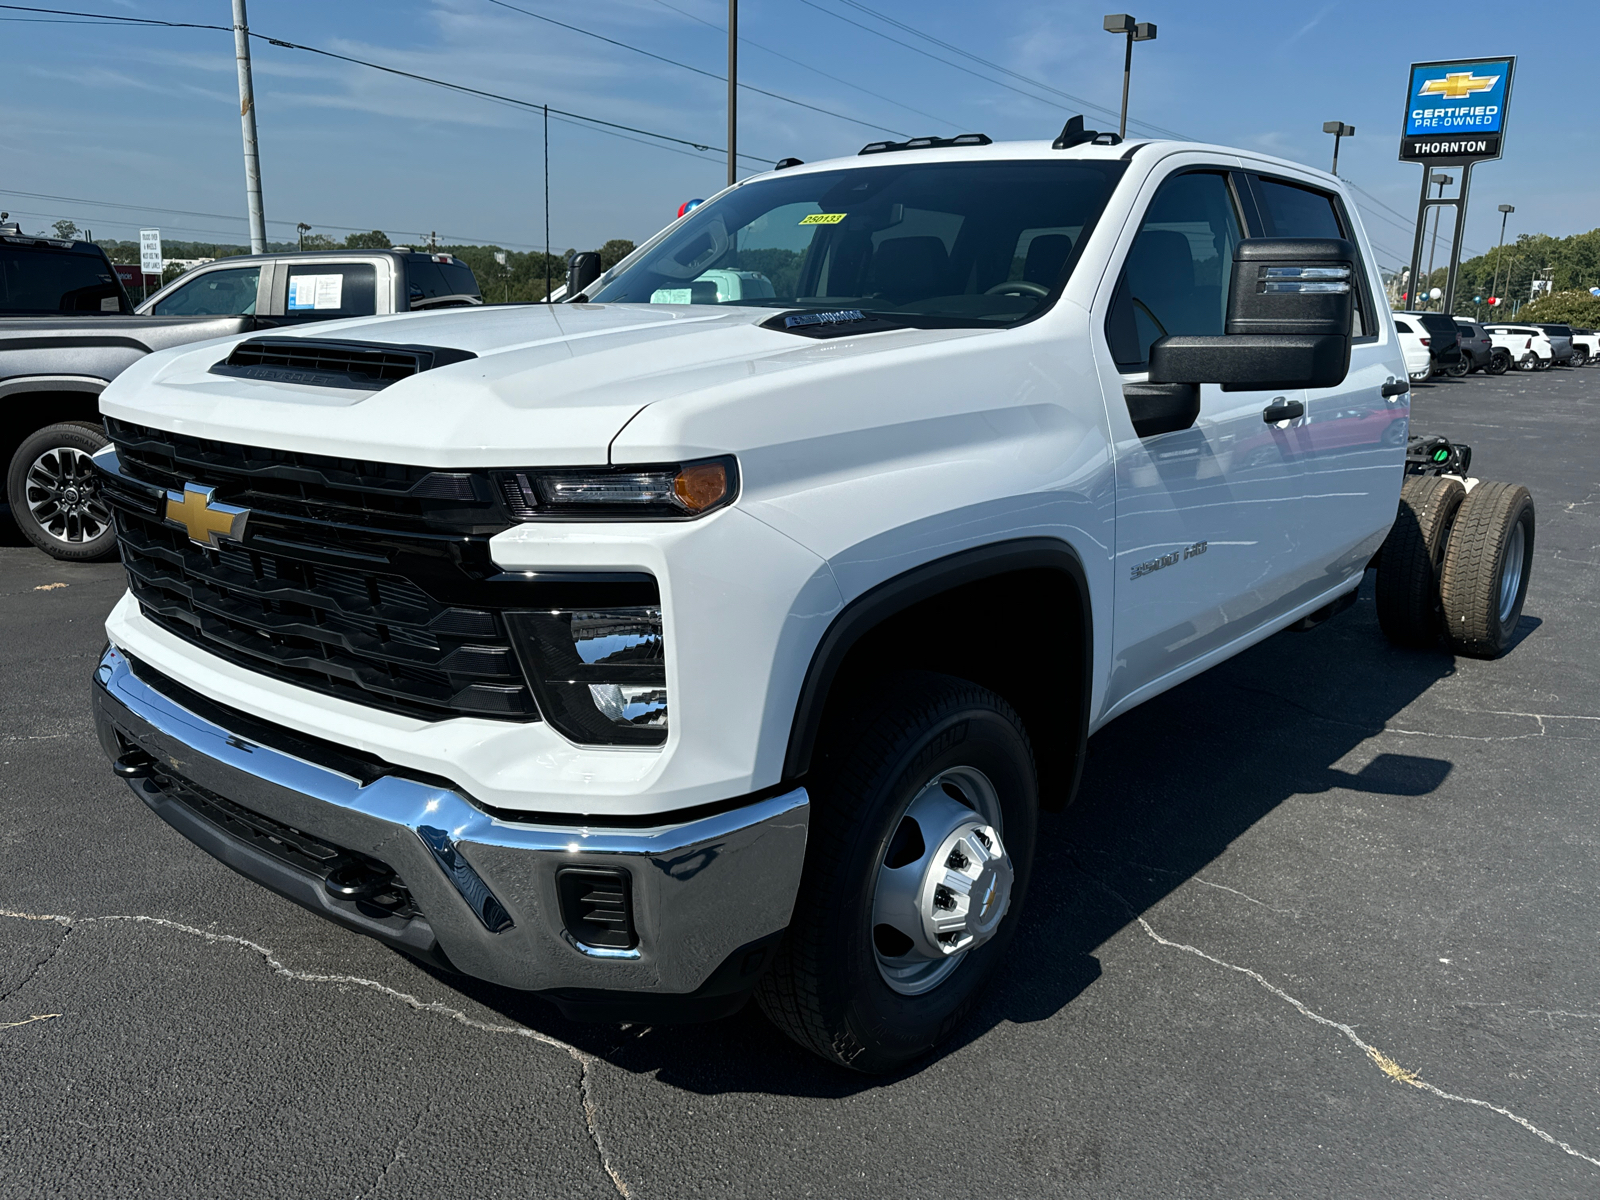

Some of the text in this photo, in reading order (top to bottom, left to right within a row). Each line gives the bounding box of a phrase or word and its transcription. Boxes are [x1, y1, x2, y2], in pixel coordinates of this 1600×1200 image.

[1412, 106, 1498, 119] CERTIFIED
[1415, 115, 1492, 128] PRE-OWNED
[1414, 141, 1486, 154] THORNTON
[1130, 540, 1207, 580] 3500 HD
